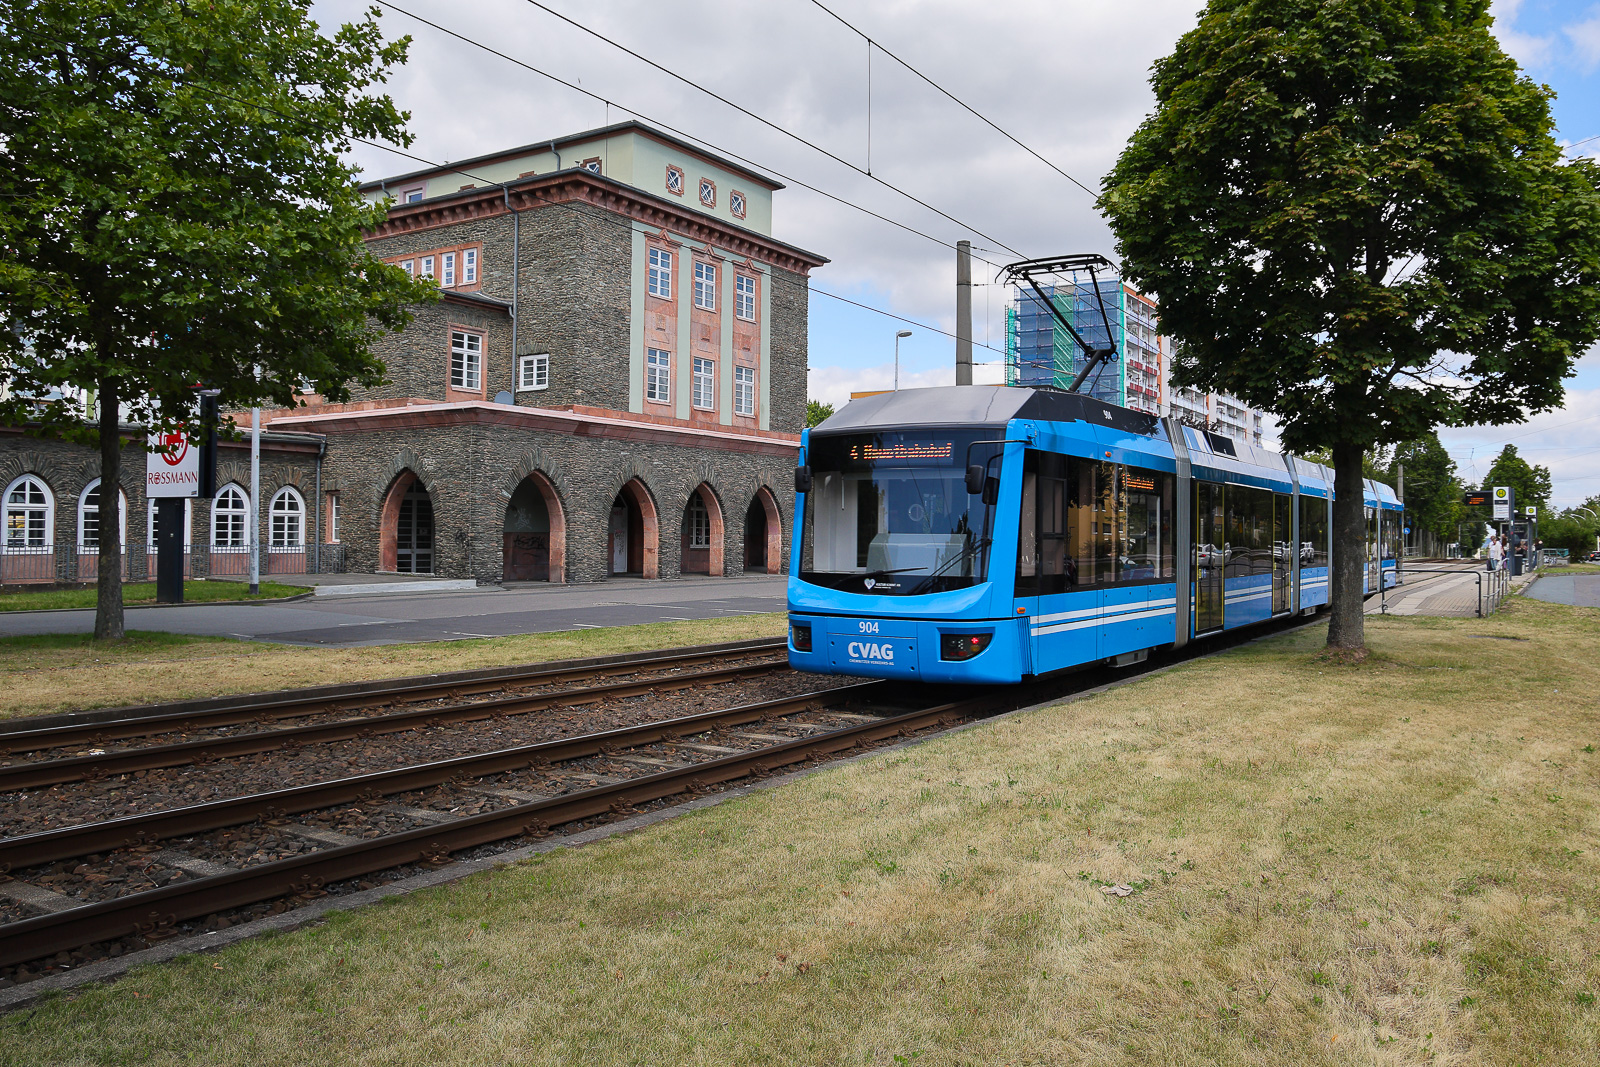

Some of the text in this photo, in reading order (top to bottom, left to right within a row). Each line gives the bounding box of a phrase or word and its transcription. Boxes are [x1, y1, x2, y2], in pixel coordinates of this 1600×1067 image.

[1103, 409, 1112, 420] 904
[148, 471, 197, 484] ROSSMANN
[859, 621, 879, 633] 904
[848, 642, 893, 660] CVAG
